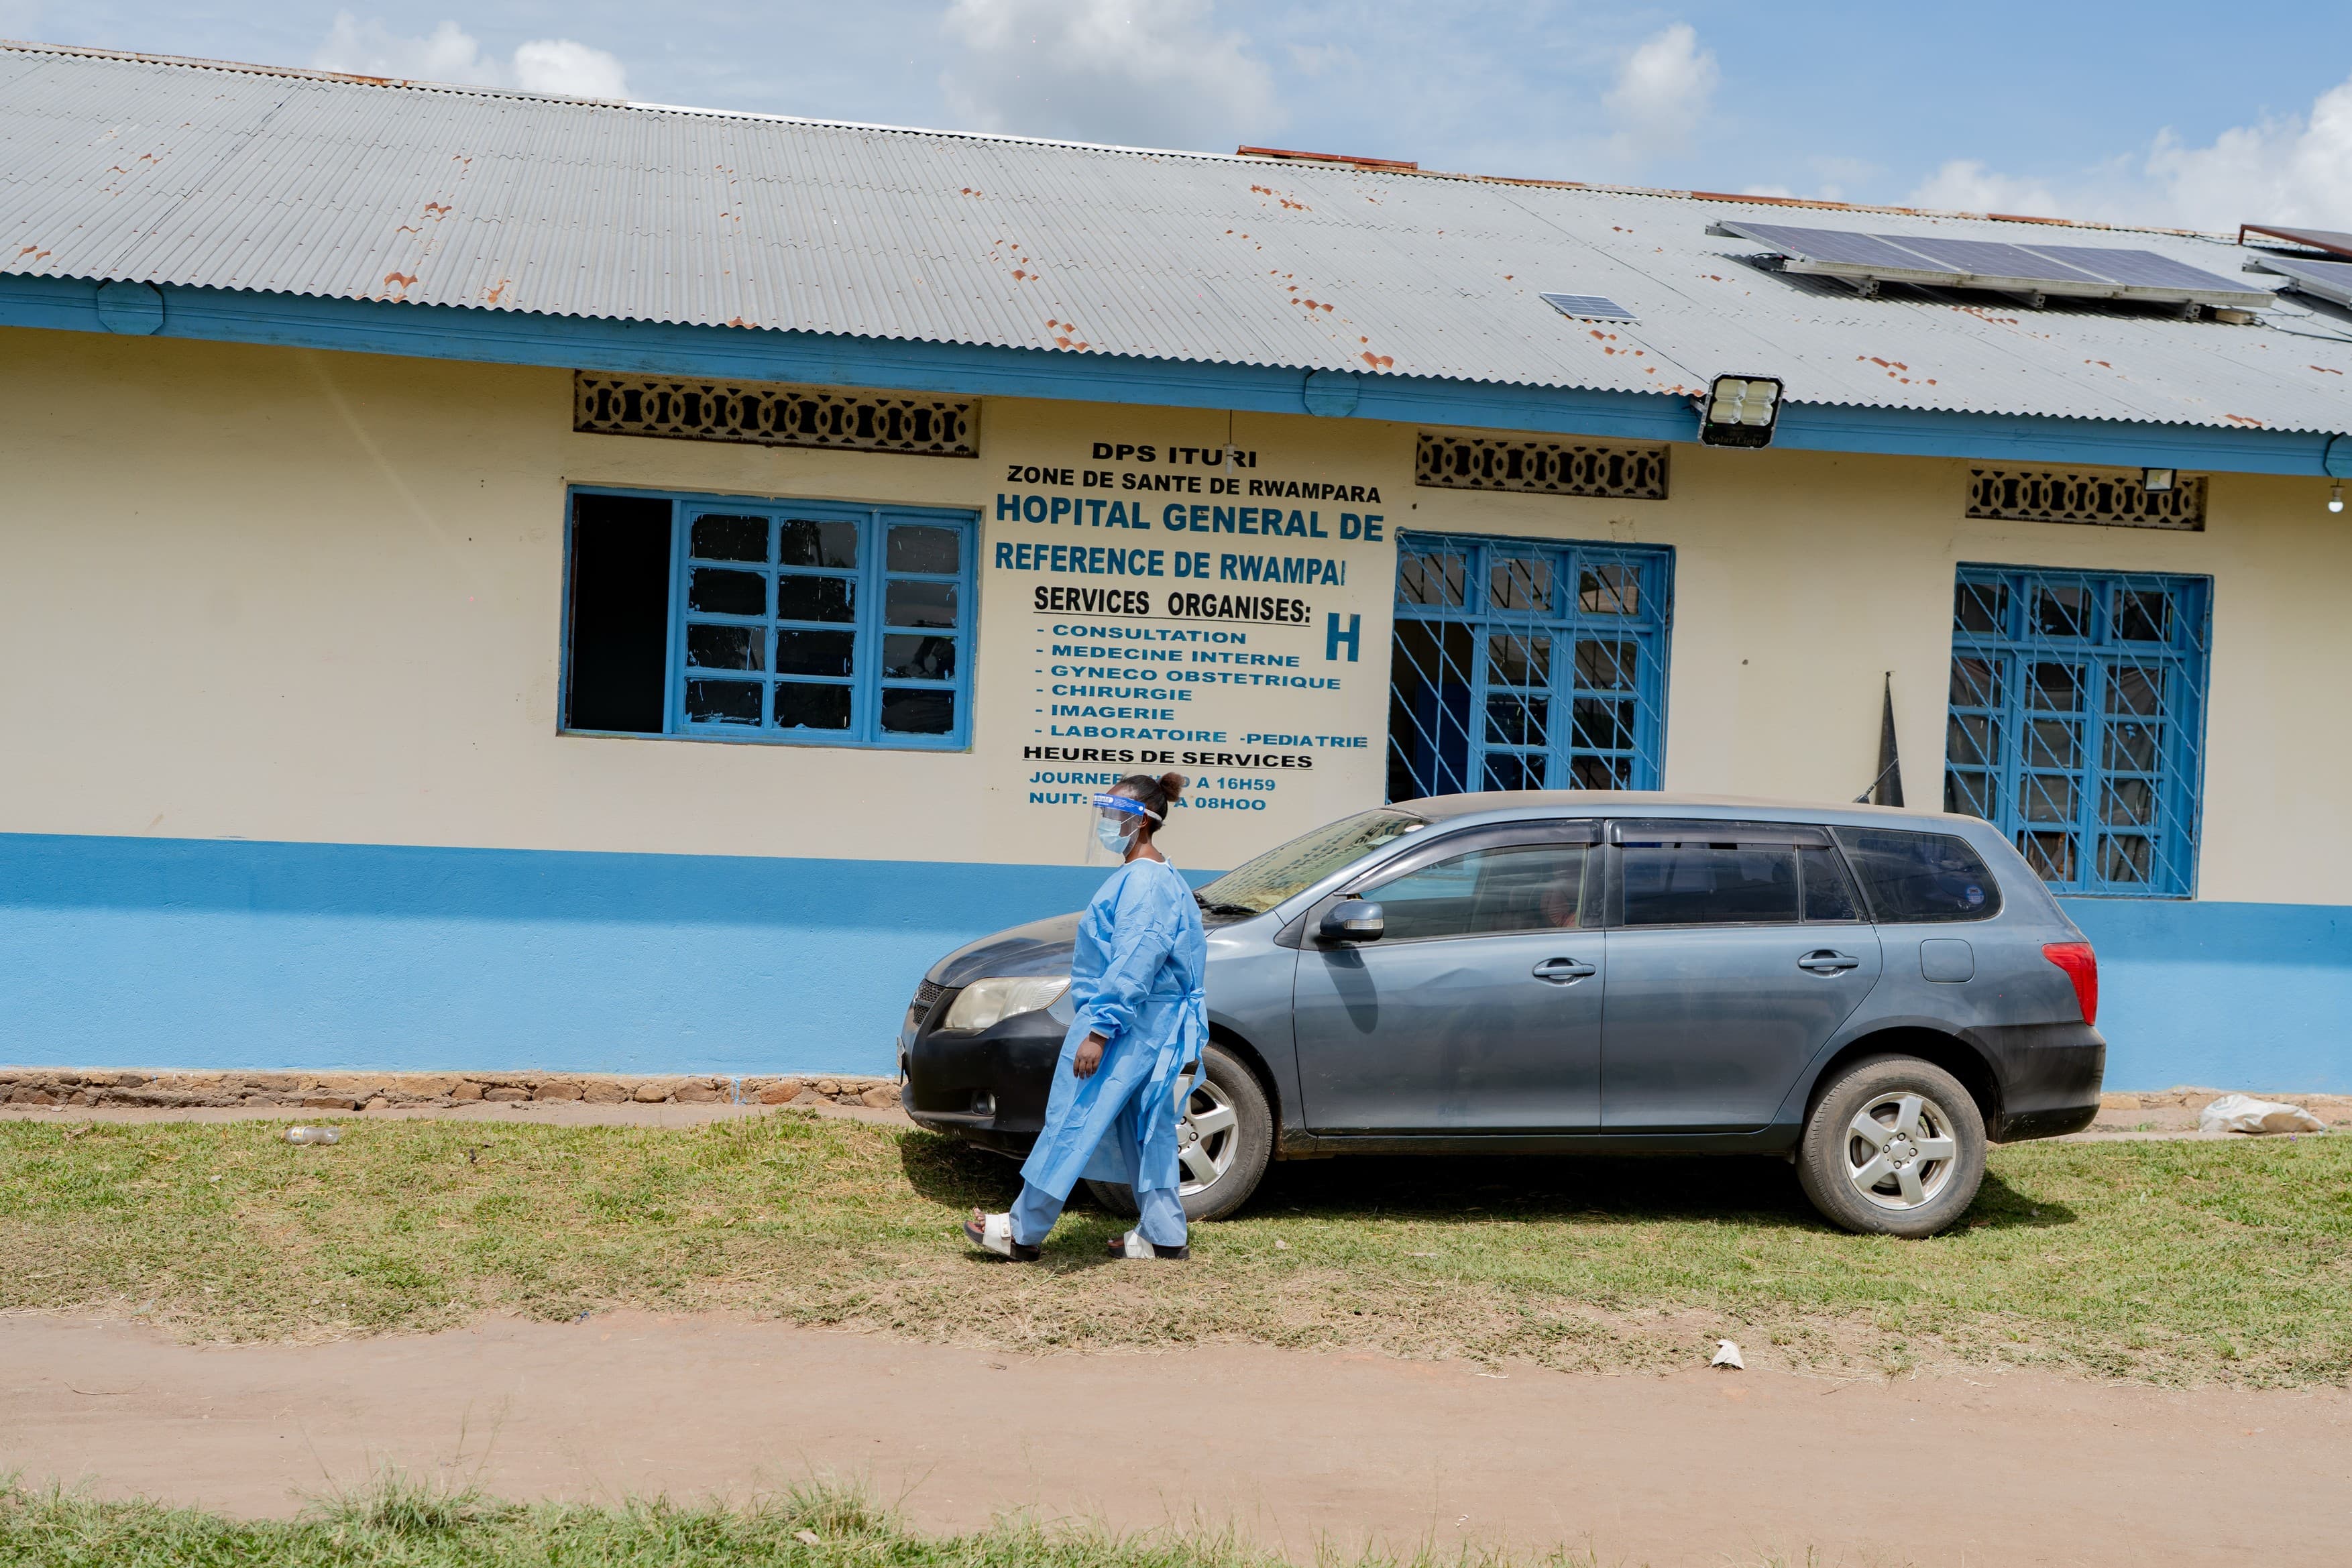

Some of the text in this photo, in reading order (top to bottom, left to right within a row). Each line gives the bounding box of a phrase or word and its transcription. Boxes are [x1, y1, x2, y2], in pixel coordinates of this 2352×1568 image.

[1092, 442, 1257, 468] DPS ITURI
[1007, 465, 1382, 504] ZONE DE SANTE DE RWAMPARA
[996, 493, 1384, 543] HOPITAL GENERAL DE
[995, 541, 1164, 577] REFERENCE
[1174, 551, 1211, 579] DE
[1033, 585, 1311, 624] SERVICES ORGANISES:
[1052, 624, 1246, 645] CONSULTATION
[1325, 612, 1361, 663] H
[1052, 644, 1183, 662] MEDECINE
[1191, 651, 1300, 667] INTERNE
[1050, 665, 1158, 681] GYNECO
[1166, 670, 1341, 690] OBSTETRIQUE
[1052, 684, 1192, 702] CHIRURGIE
[1051, 704, 1174, 721] IMAGERIE
[1051, 724, 1227, 743] LABORATOIRE
[1023, 746, 1312, 769] HEURES DE SERVICES
[1196, 777, 1210, 789] A
[1217, 777, 1276, 791] 16H59
[1029, 792, 1088, 805] NUIT:
[1174, 797, 1188, 808] A
